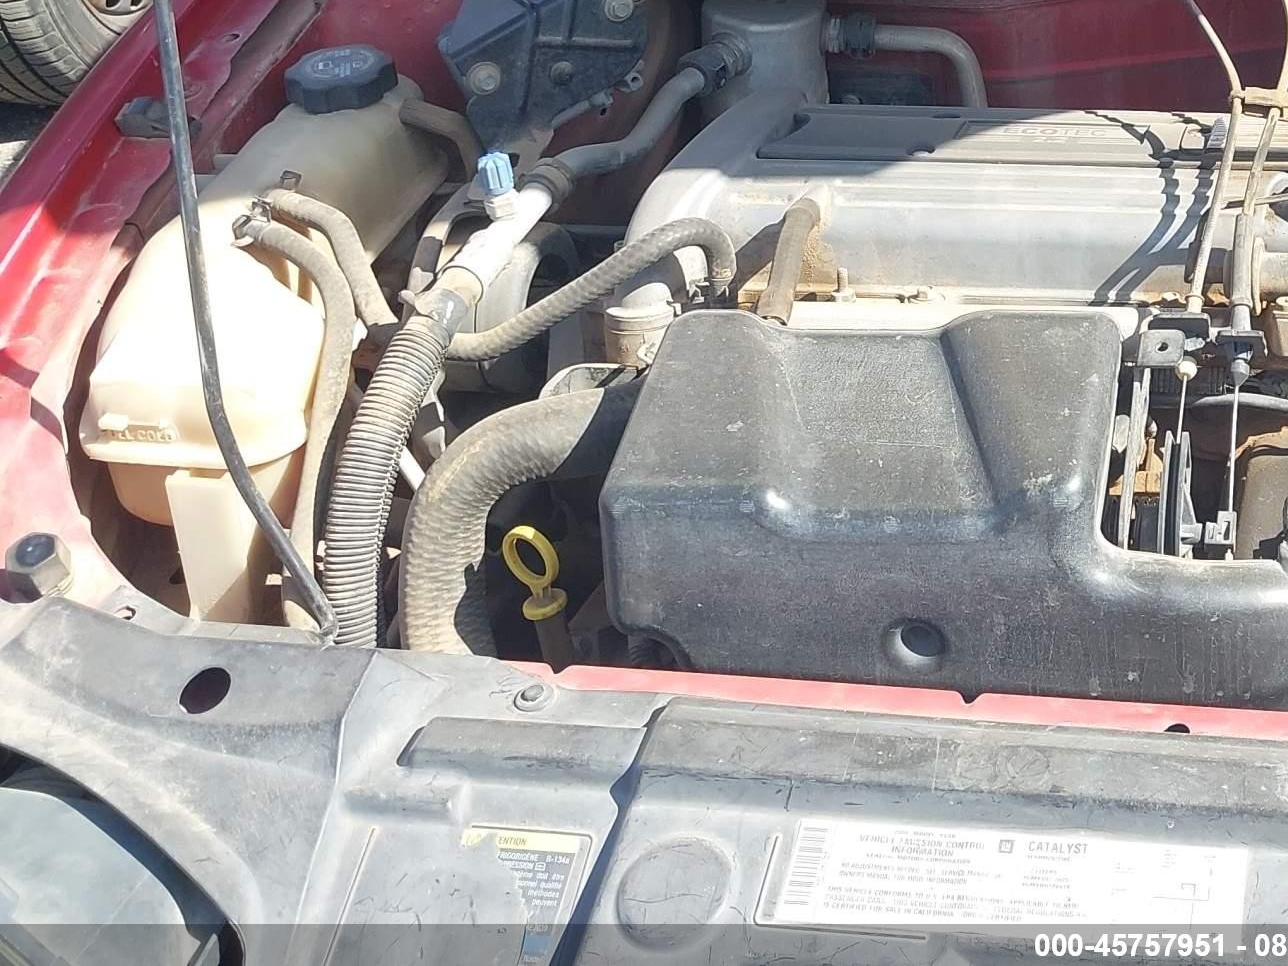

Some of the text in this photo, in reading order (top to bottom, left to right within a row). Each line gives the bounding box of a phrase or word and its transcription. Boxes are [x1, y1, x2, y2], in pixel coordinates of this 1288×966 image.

[1002, 127, 1108, 137] ECOTEC
[891, 845, 954, 857] INFORMATION
[1028, 841, 1088, 855] CATALYST
